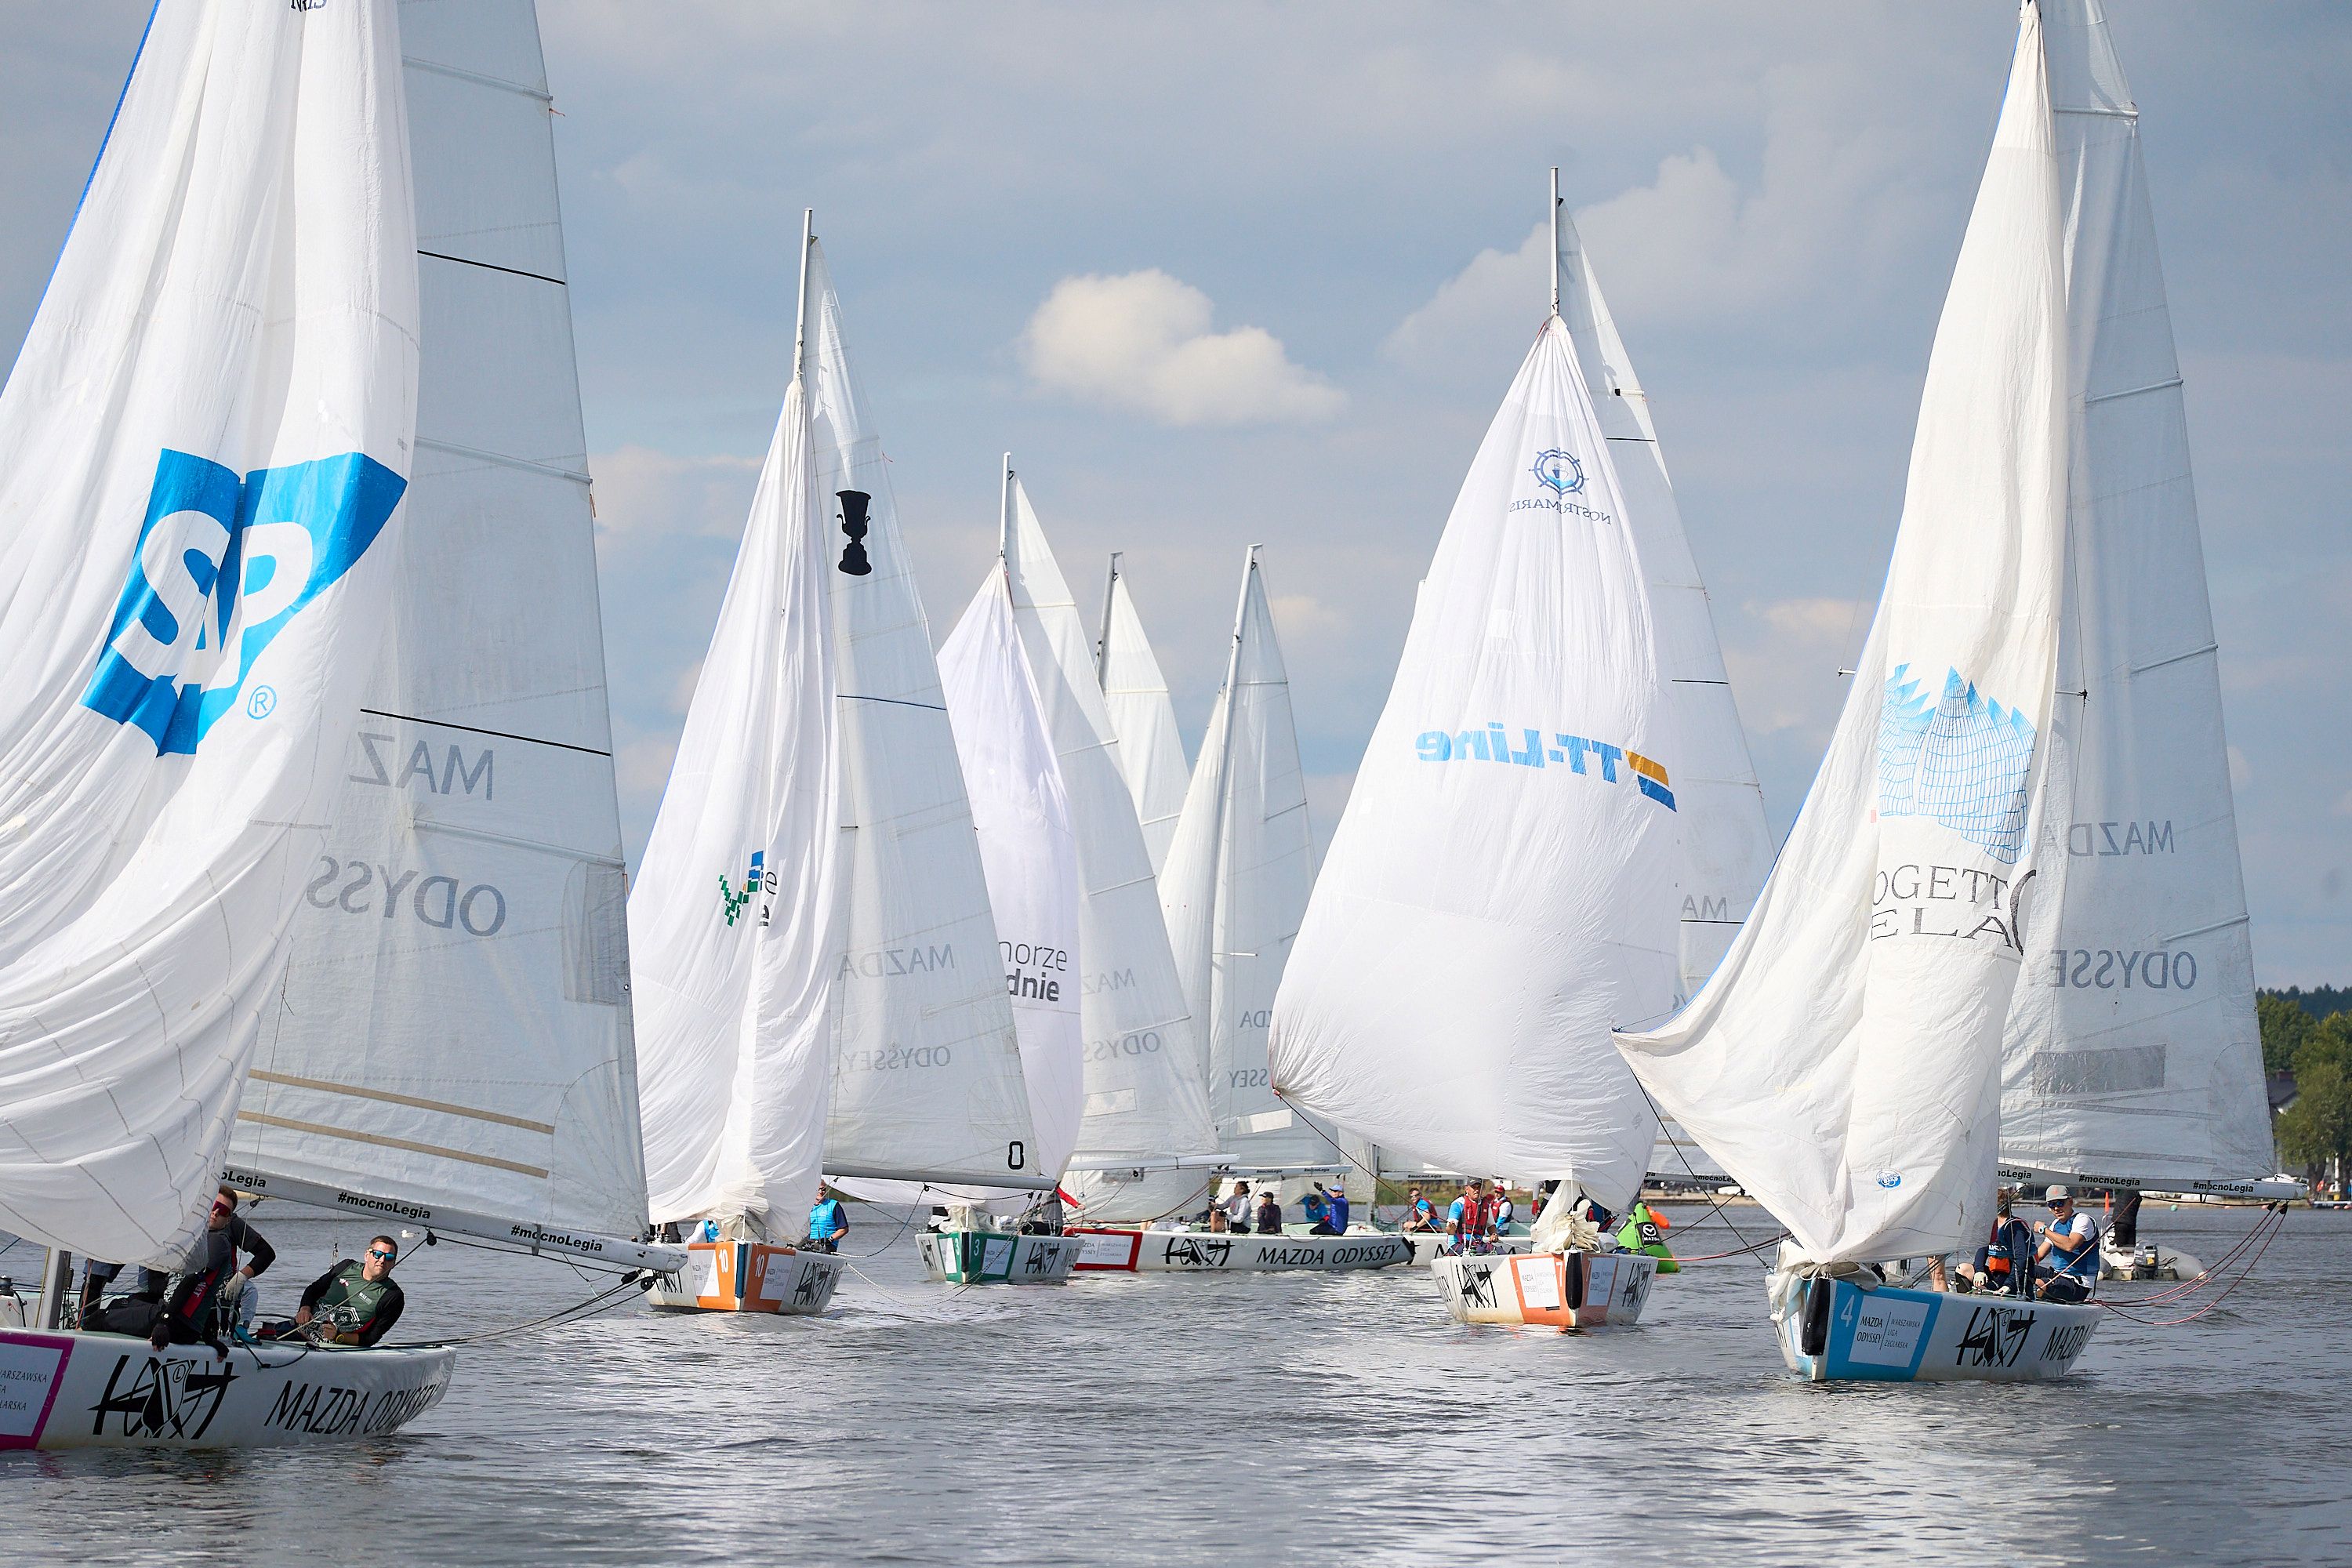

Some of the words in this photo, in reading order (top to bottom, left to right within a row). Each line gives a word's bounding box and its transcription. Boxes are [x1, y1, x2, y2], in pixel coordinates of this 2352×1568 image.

[111, 510, 313, 701] SAP
[2078, 1174, 2140, 1187] #mocnoLegia
[338, 1192, 431, 1220] #mocnoLegia
[973, 1238, 980, 1257] 3
[1256, 1247, 1325, 1265] MAZDA
[1332, 1244, 1400, 1264] ODYSSEY
[719, 1249, 729, 1273] 10
[755, 1254, 765, 1278] 10
[1840, 1294, 1855, 1327] 4
[1860, 1316, 1883, 1327] MAZDA
[1891, 1319, 1921, 1328] WARSZAWSKA
[1857, 1331, 1882, 1344] ODYSSEY
[263, 1380, 370, 1435] MAZDA
[363, 1381, 442, 1435] ODYSSEY
